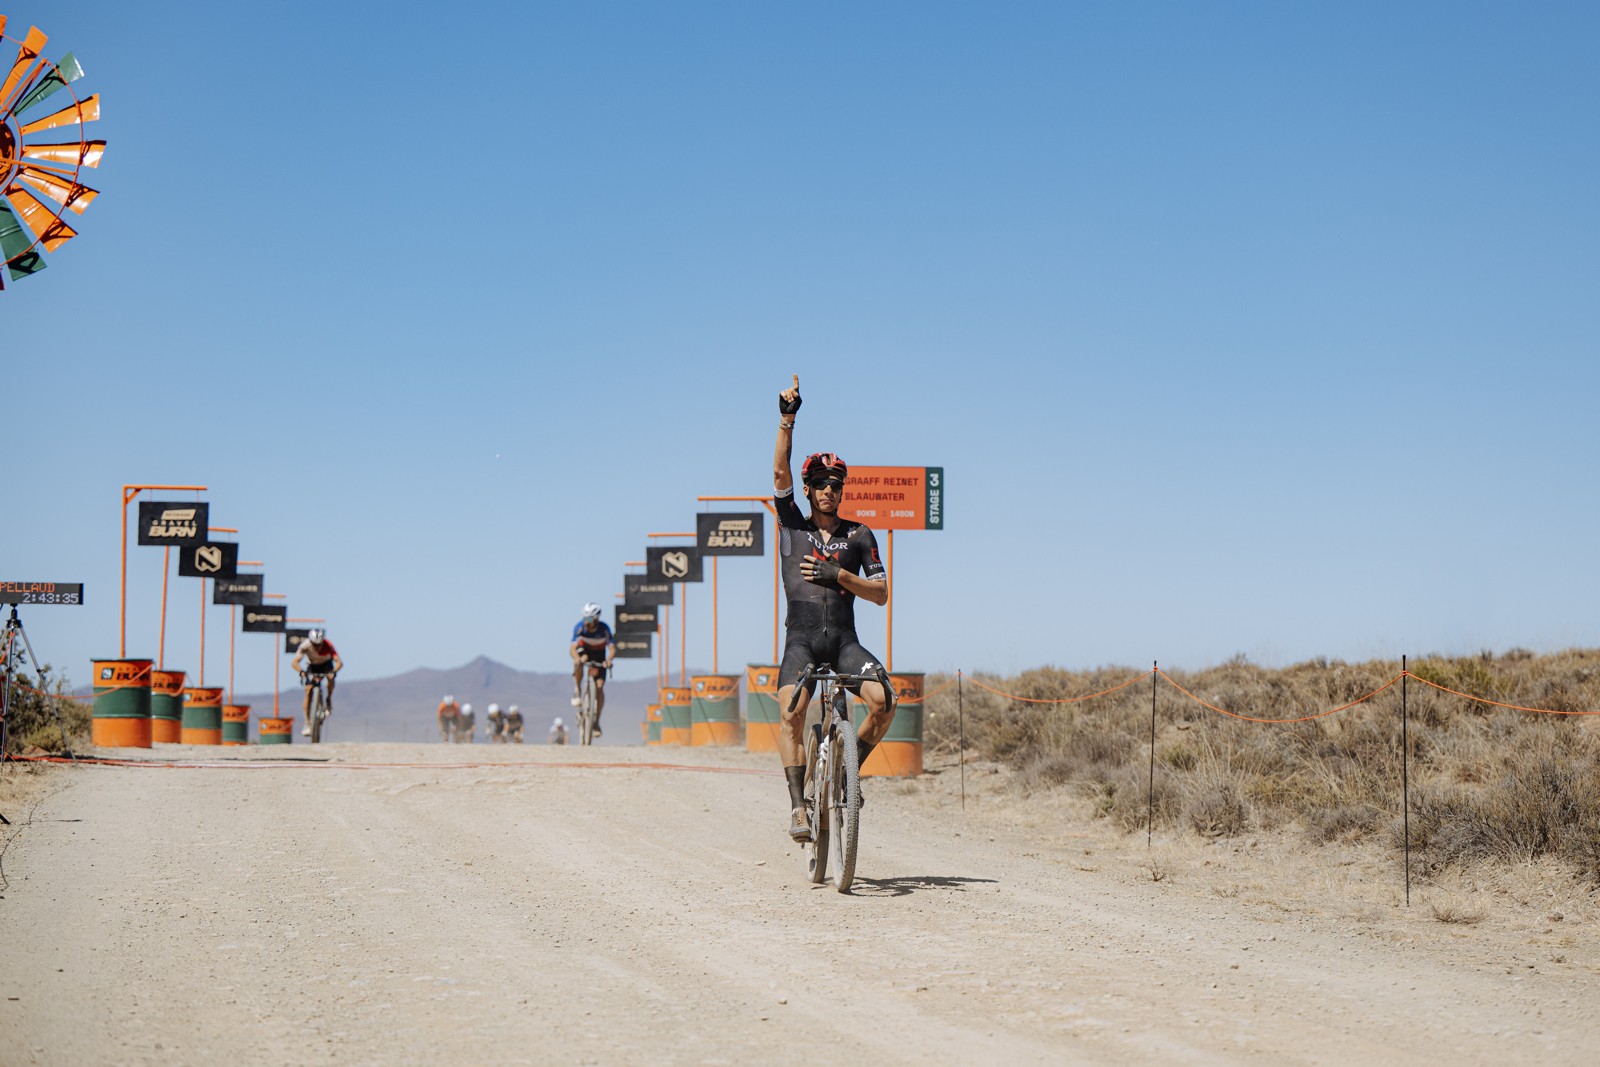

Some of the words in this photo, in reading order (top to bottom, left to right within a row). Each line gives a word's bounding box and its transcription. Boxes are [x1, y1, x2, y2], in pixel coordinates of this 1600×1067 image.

[845, 477, 880, 486] GRAAFF
[883, 478, 919, 486] REINET
[930, 473, 940, 487] 3
[845, 492, 905, 501] BLAAUWATER
[930, 489, 940, 524] STAGE
[148, 526, 197, 537] BURN
[707, 536, 754, 547] BURN
[0, 582, 55, 593] PELLAUD
[22, 592, 79, 604] 2:43:35
